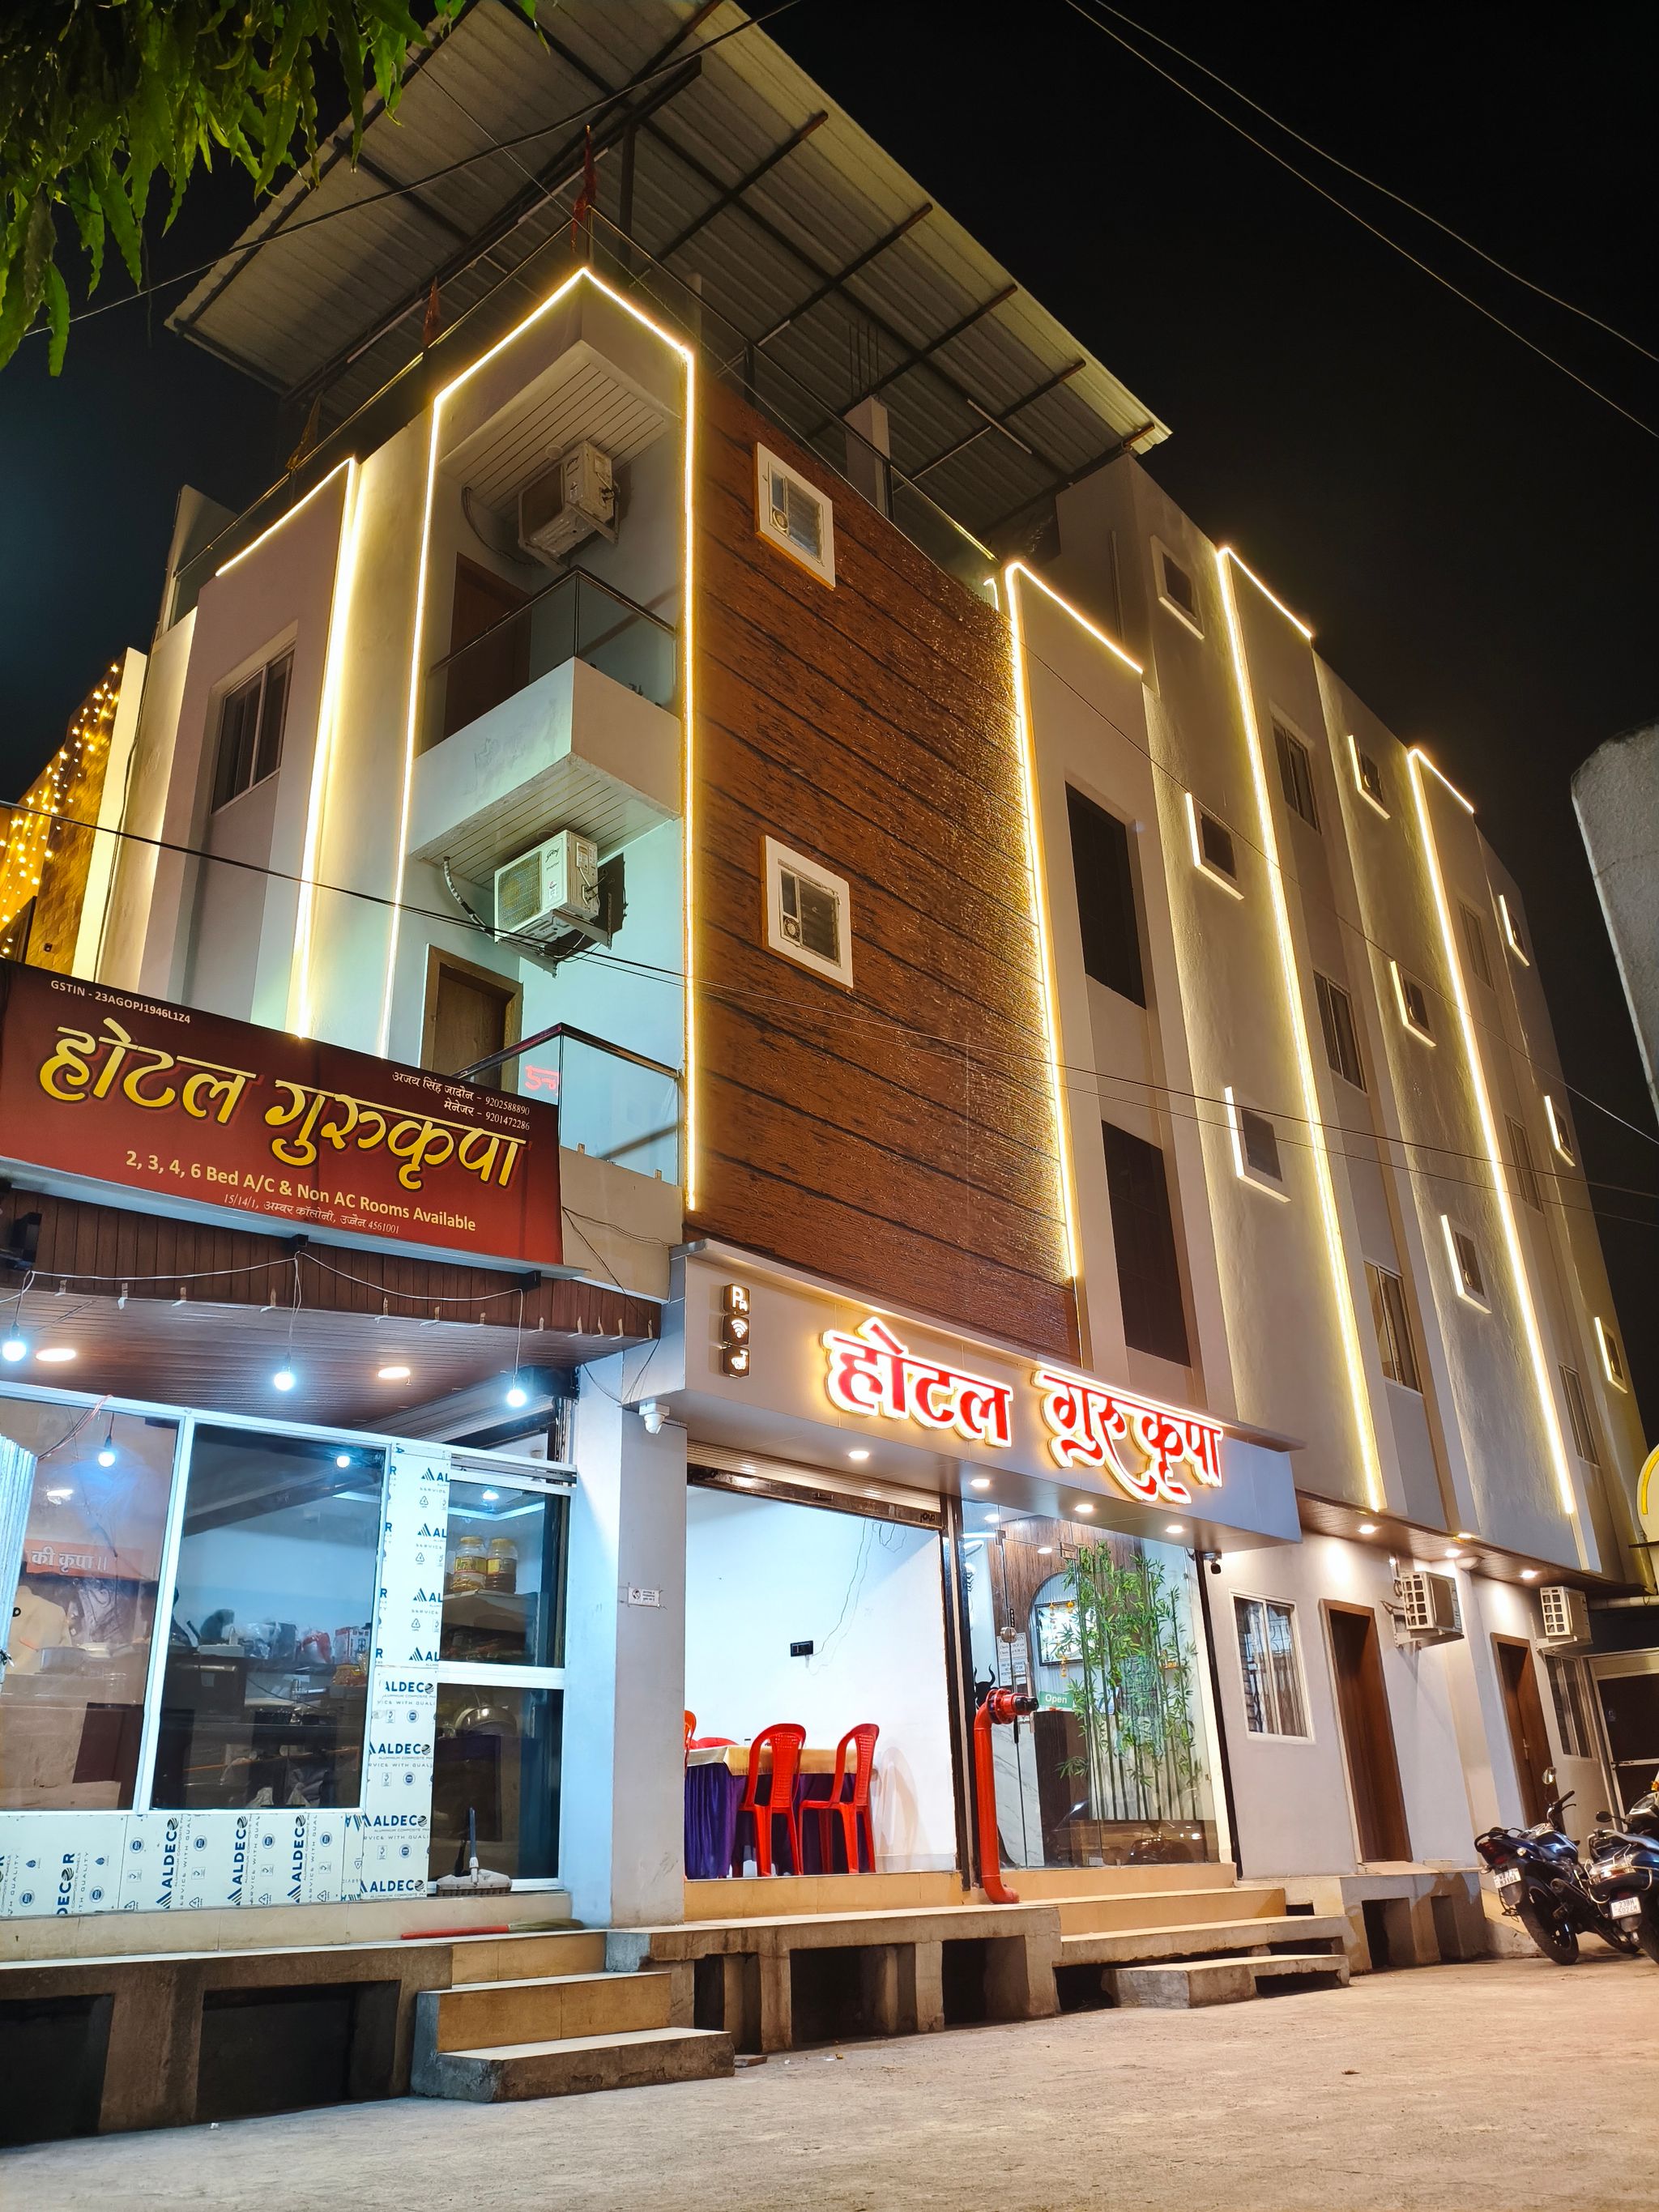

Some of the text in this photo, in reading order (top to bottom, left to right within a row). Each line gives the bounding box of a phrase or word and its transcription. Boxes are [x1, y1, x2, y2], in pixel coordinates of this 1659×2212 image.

[50, 980, 85, 997] GSTIN
[40, 1017, 257, 1123] होटल
[392, 1071, 420, 1087] अजय
[422, 1076, 443, 1093] सिंह
[443, 1097, 476, 1117] मेनेजर
[126, 1150, 476, 1232] 2, 3, 4, 6 Bed A/C & Non AC Rooms Available
[822, 1316, 1013, 1447] होटल
[31, 1546, 56, 1567] की
[59, 1553, 95, 1572] कृपा
[1045, 1694, 1068, 1705] Open
[11, 1855, 19, 1895] QUALITY
[81, 1852, 89, 1892] QUALITY
